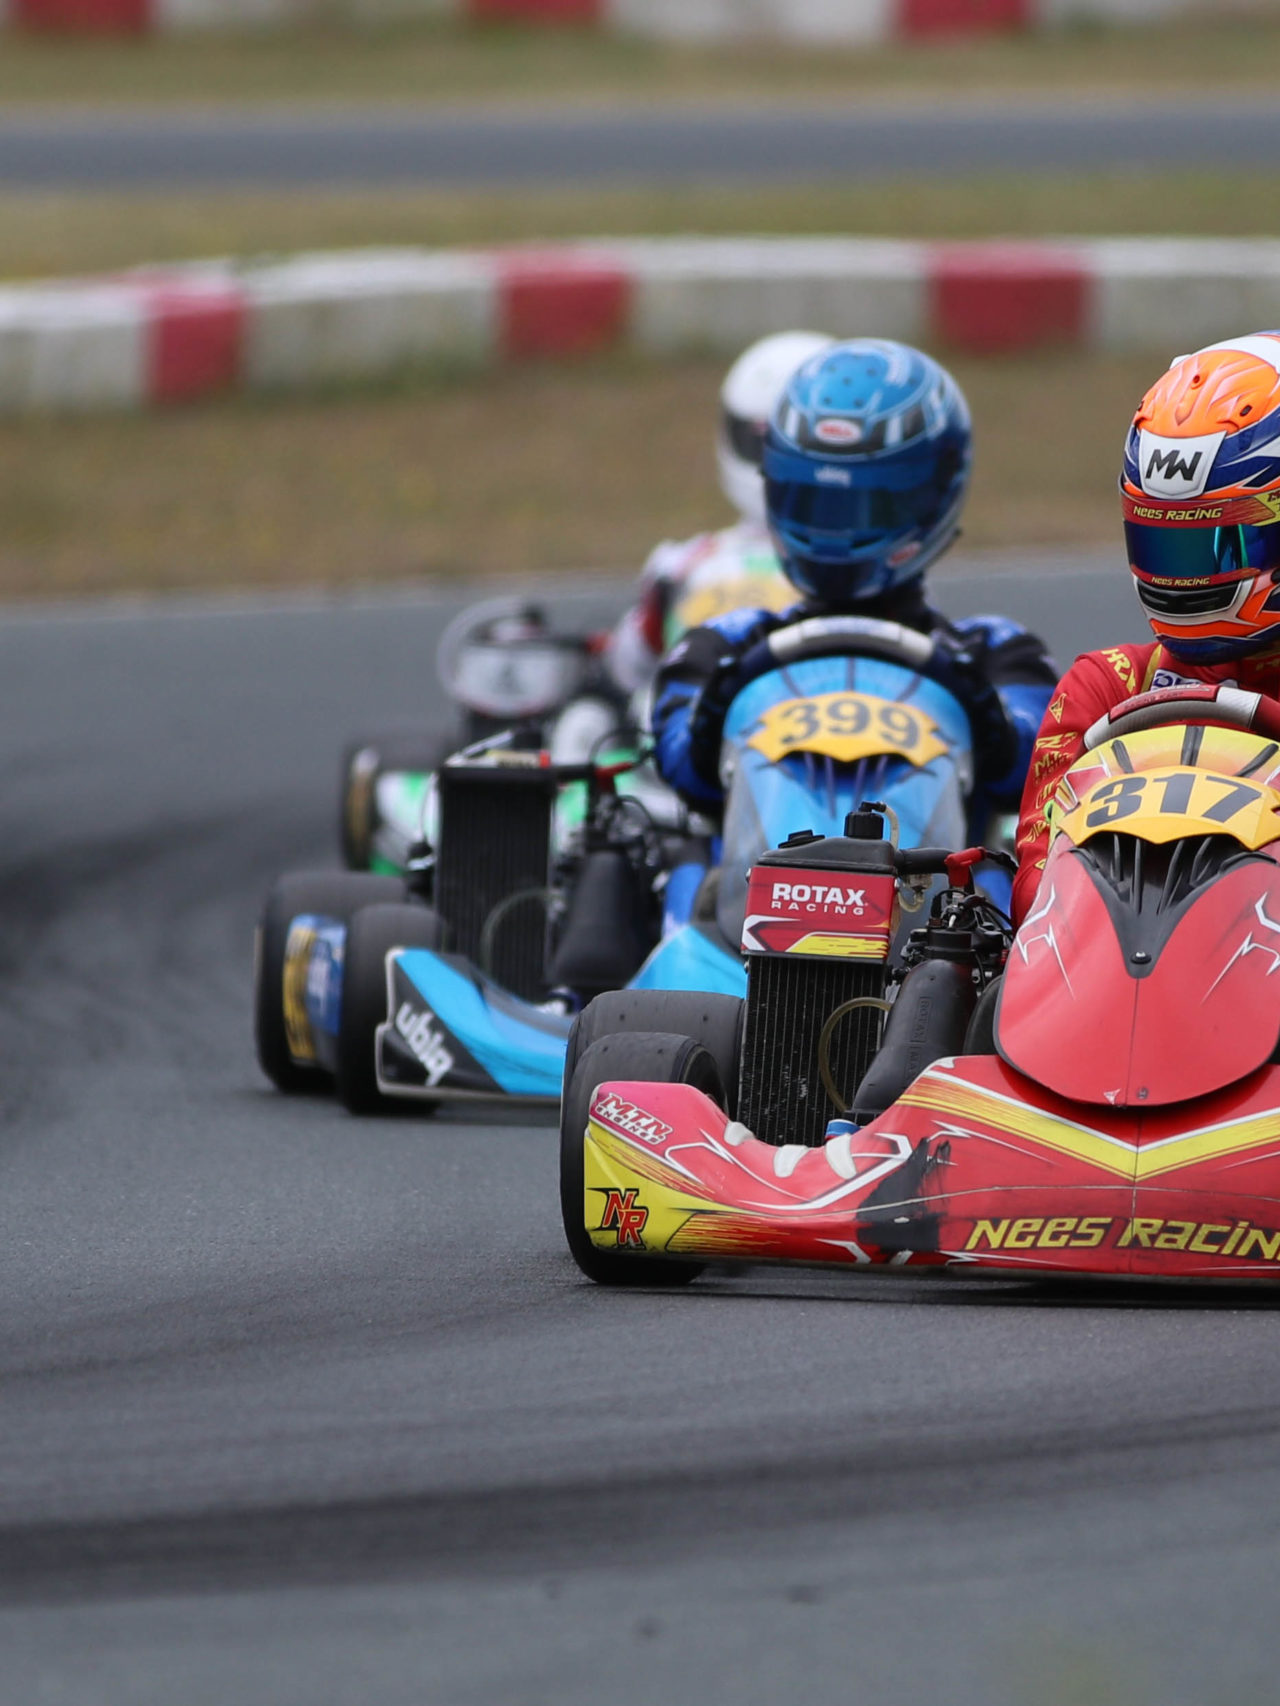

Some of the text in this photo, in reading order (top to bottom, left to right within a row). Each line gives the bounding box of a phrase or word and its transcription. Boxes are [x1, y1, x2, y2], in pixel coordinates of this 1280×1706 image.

[1145, 448, 1203, 481] MW
[778, 698, 920, 749] 399
[1086, 772, 1263, 828] 317
[771, 900, 864, 916] RACING
[772, 882, 865, 907] ROTAX
[396, 1001, 454, 1087] ubiq
[601, 1190, 648, 1245] NR
